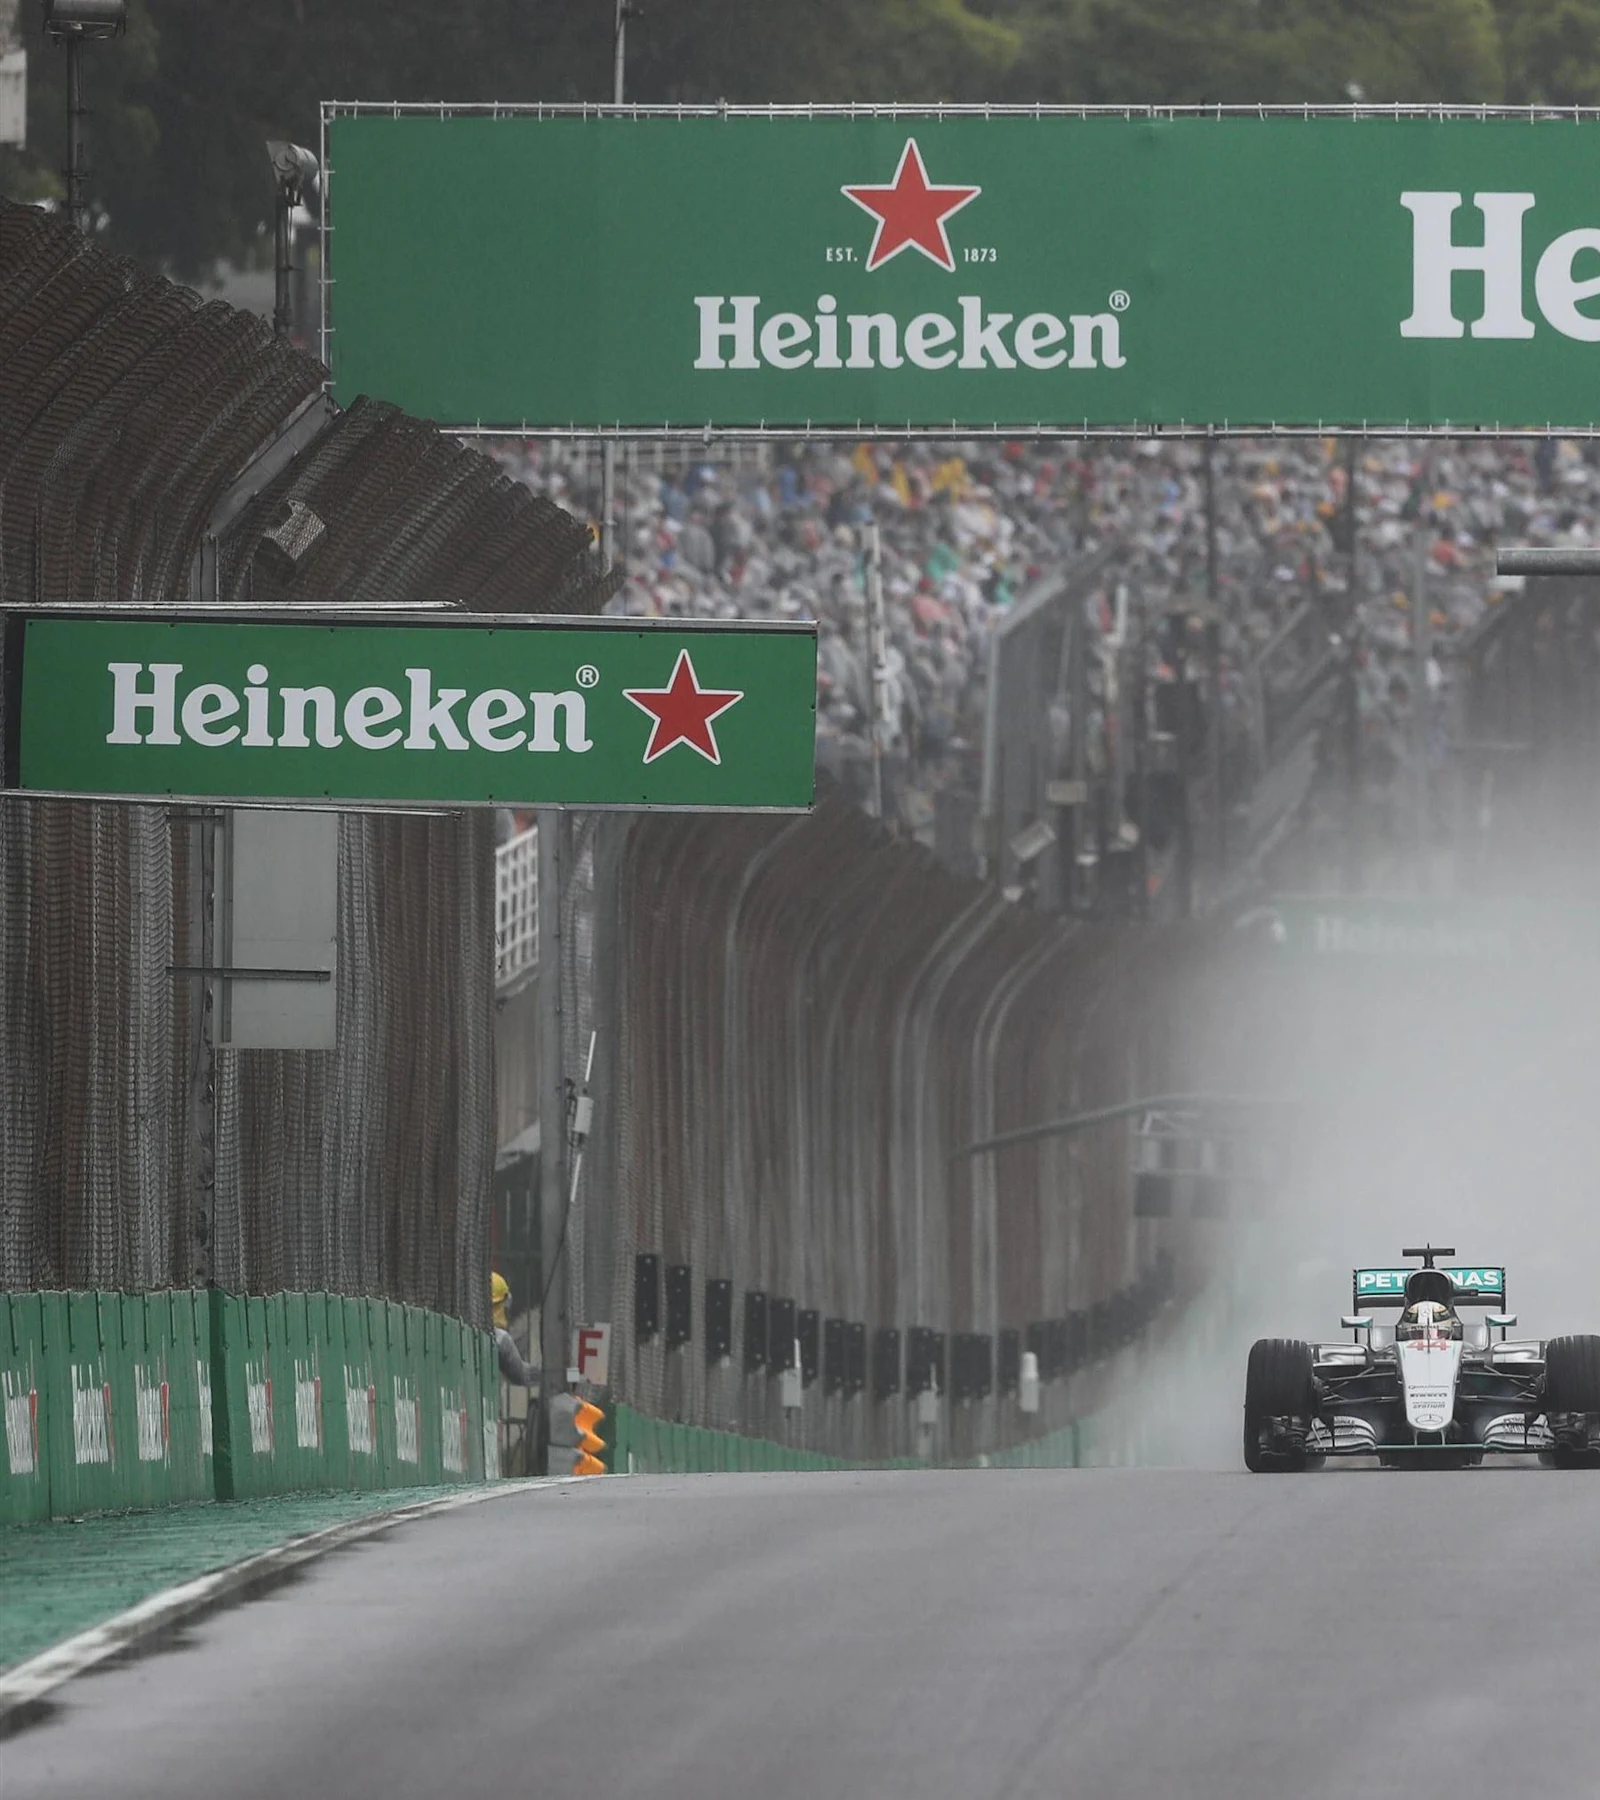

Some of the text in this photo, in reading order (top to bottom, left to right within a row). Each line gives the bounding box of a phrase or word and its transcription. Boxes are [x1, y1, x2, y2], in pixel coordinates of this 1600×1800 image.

[826, 247, 997, 262] EST. 1873
[1360, 1271, 1499, 1288] PETNAS
[578, 1331, 603, 1374] F
